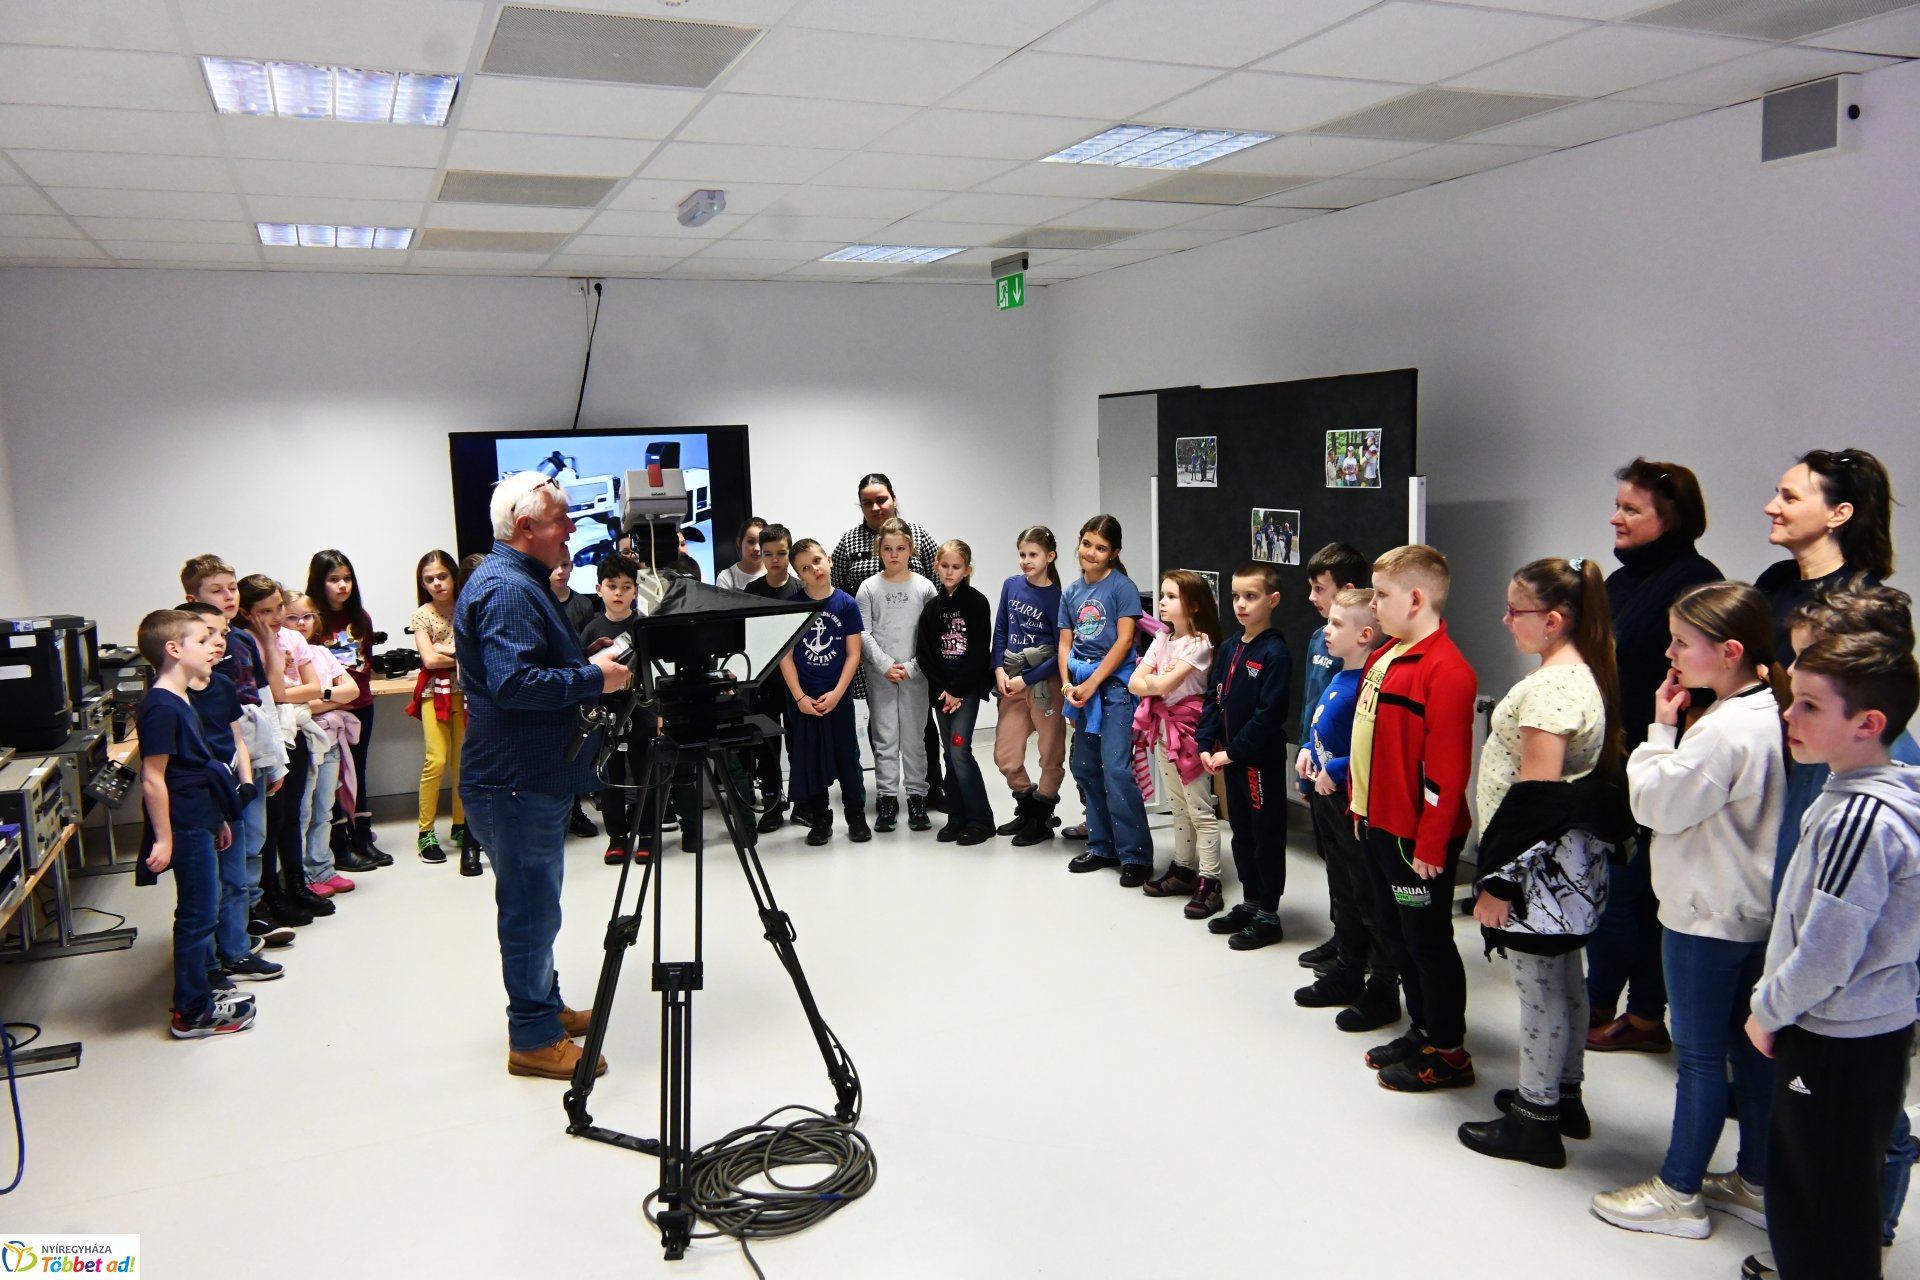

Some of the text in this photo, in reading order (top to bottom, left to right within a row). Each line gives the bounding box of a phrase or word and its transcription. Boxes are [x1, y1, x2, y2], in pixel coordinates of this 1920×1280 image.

[1008, 599, 1044, 620] CHARM
[804, 649, 838, 664] CAPTAIN
[1247, 766, 1261, 810] LOREM
